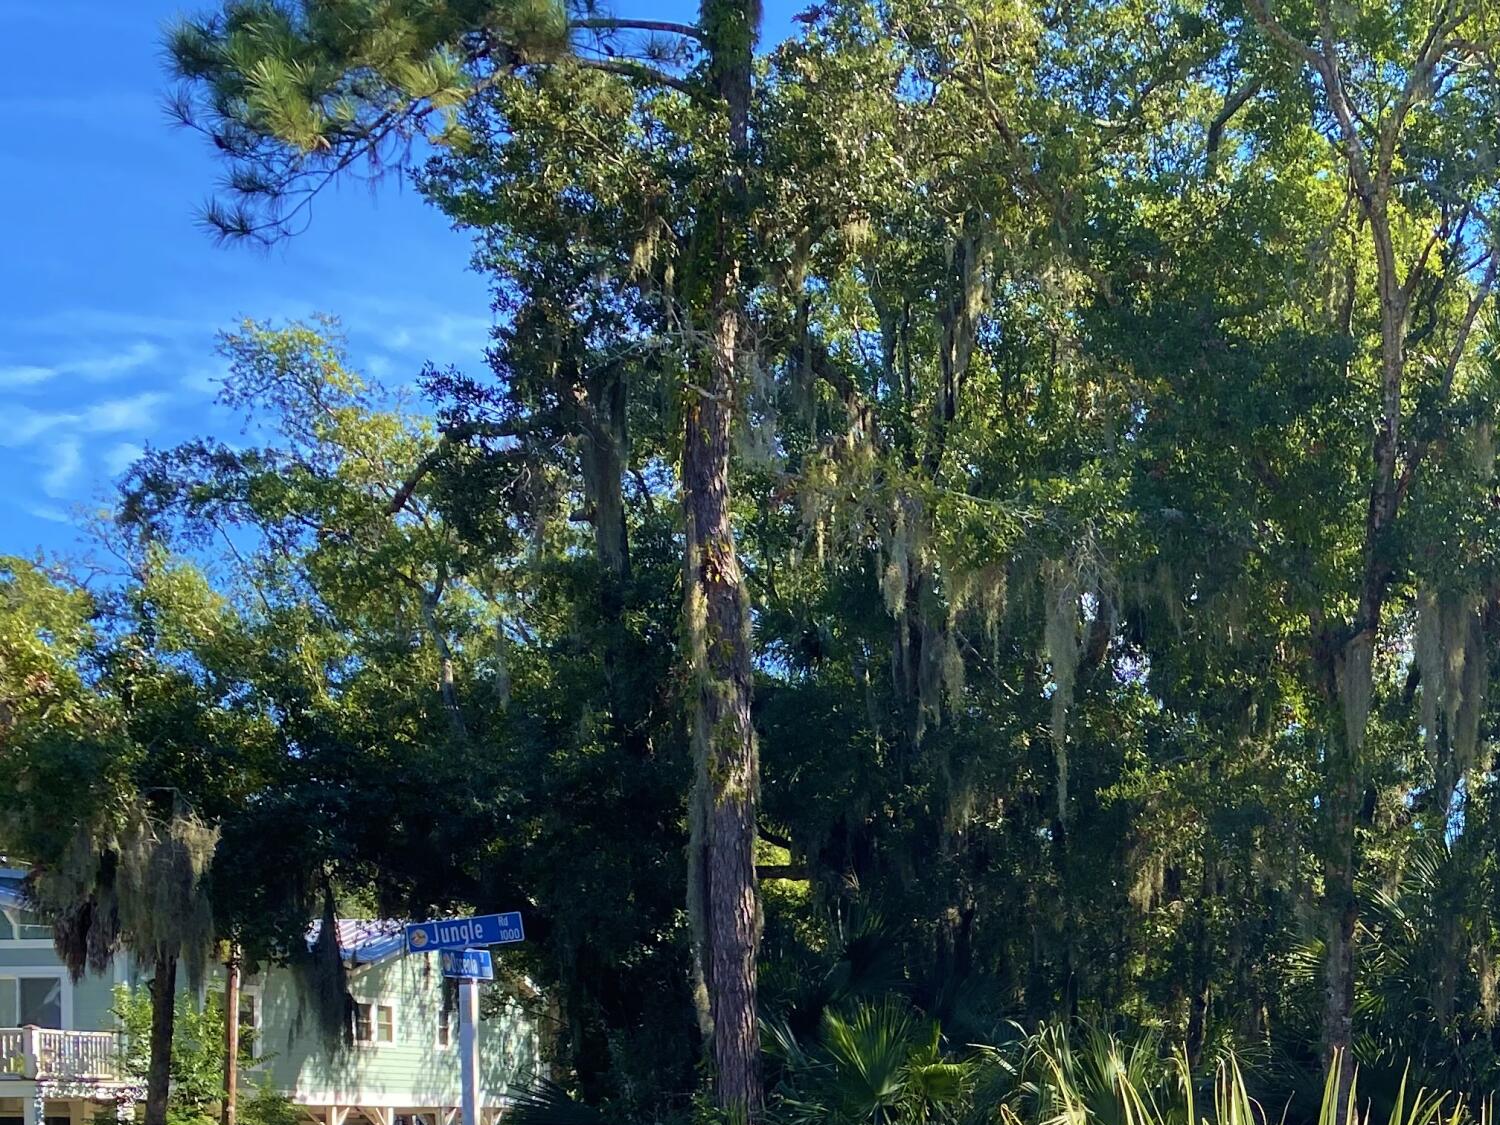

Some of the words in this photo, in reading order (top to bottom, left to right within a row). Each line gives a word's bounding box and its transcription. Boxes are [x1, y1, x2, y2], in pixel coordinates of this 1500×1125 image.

[430, 921, 483, 945] Jungle
[498, 916, 508, 926] Rd
[500, 928, 520, 940] 1000
